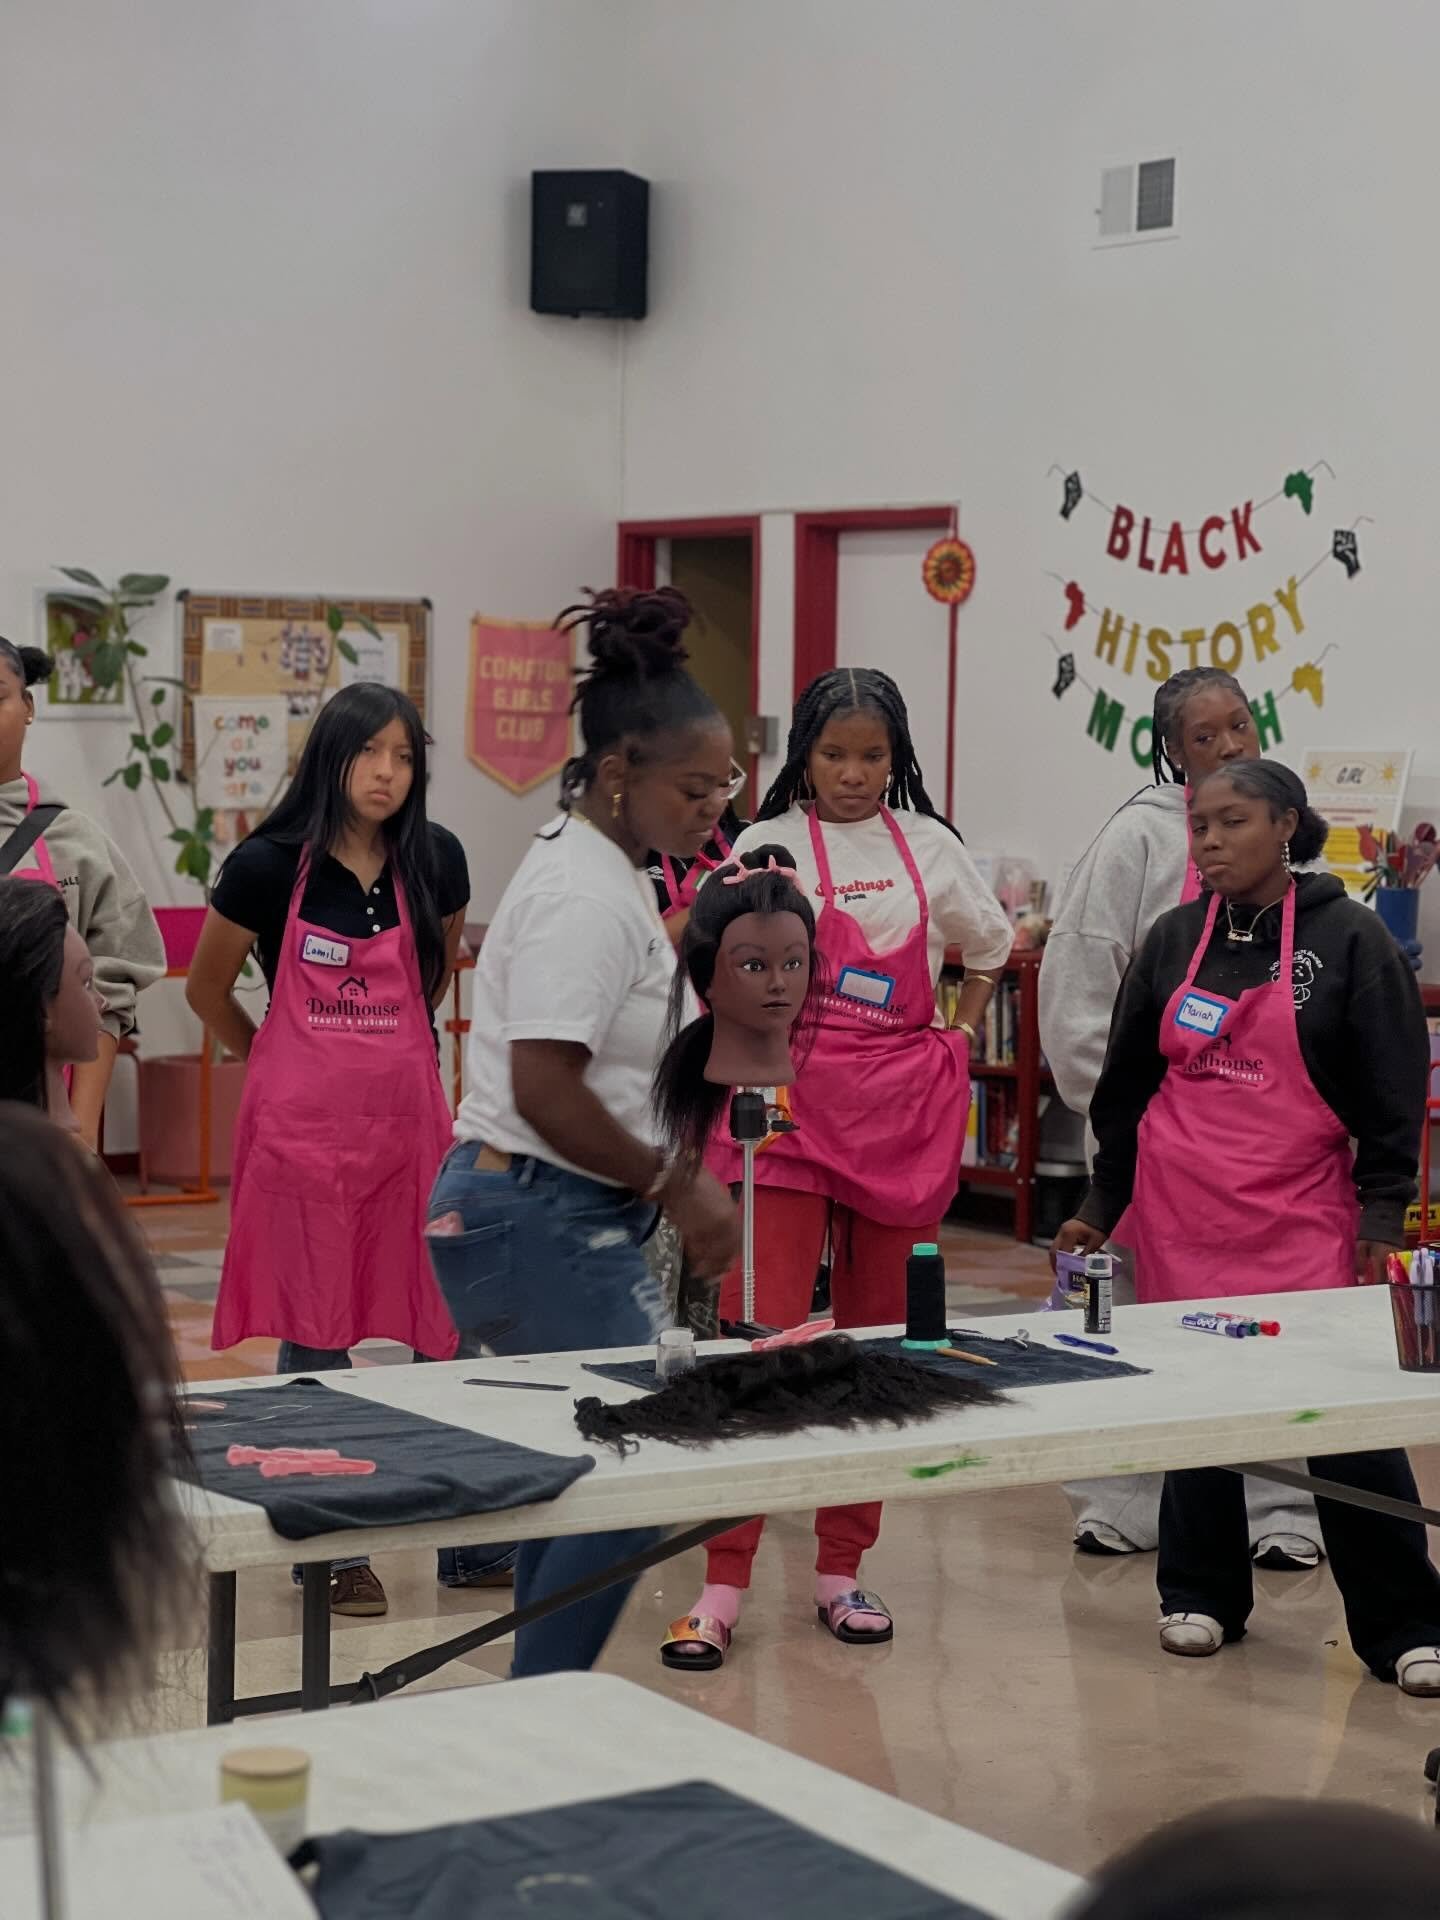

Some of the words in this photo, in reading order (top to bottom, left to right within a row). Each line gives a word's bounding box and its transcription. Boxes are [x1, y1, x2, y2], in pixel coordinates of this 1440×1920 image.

[1106, 500, 1262, 575] BLACK
[1095, 576, 1305, 682] HISTORY
[493, 688, 553, 713] GIRLS
[214, 715, 270, 735] come
[496, 717, 545, 743] CLUB
[1086, 688, 1283, 768] MOH
[224, 757, 261, 777] you
[844, 893, 867, 904] from
[306, 997, 400, 1016] Dollhouse
[823, 998, 851, 1010] EAUTY
[1183, 1002, 1214, 1021] Mariah
[308, 1016, 341, 1025] BEAUTY
[357, 1018, 399, 1027] BUSINESS
